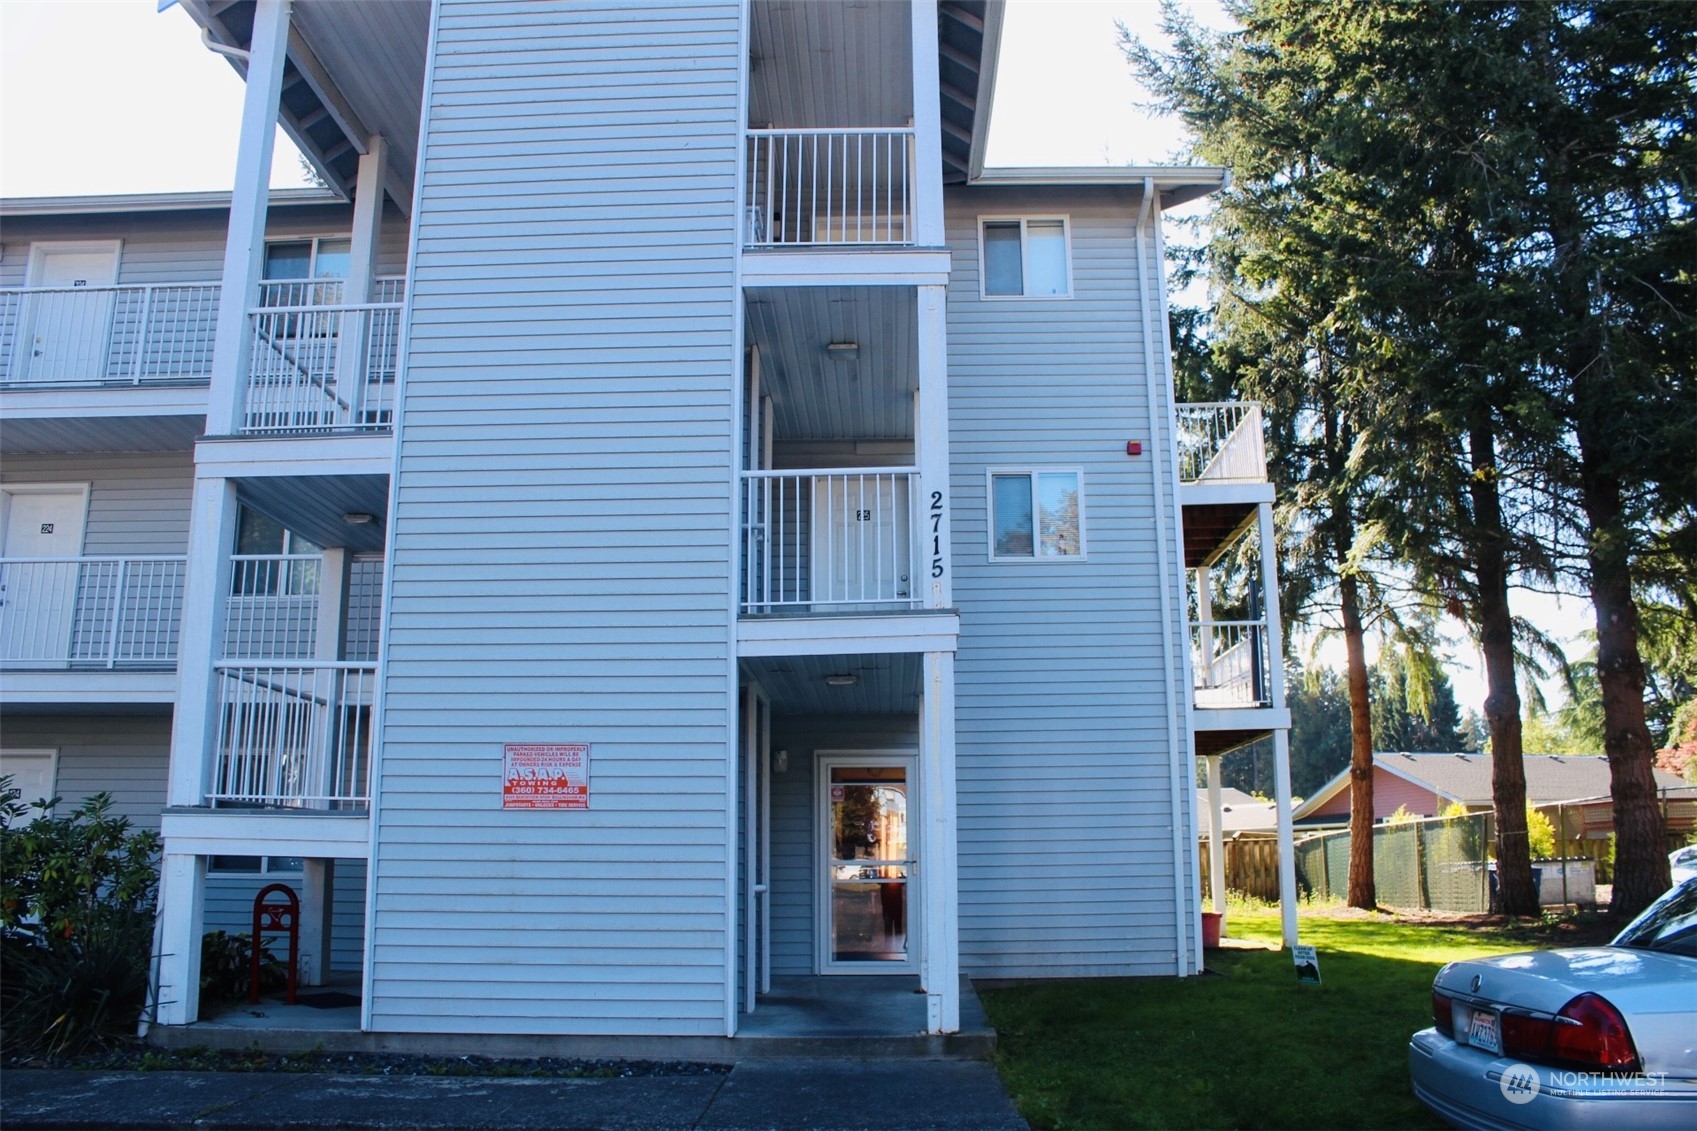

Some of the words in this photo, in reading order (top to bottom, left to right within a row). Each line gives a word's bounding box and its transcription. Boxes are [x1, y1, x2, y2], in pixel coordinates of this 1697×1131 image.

[857, 510, 870, 520] 25
[42, 524, 54, 534] 224
[930, 491, 944, 578] 2715
